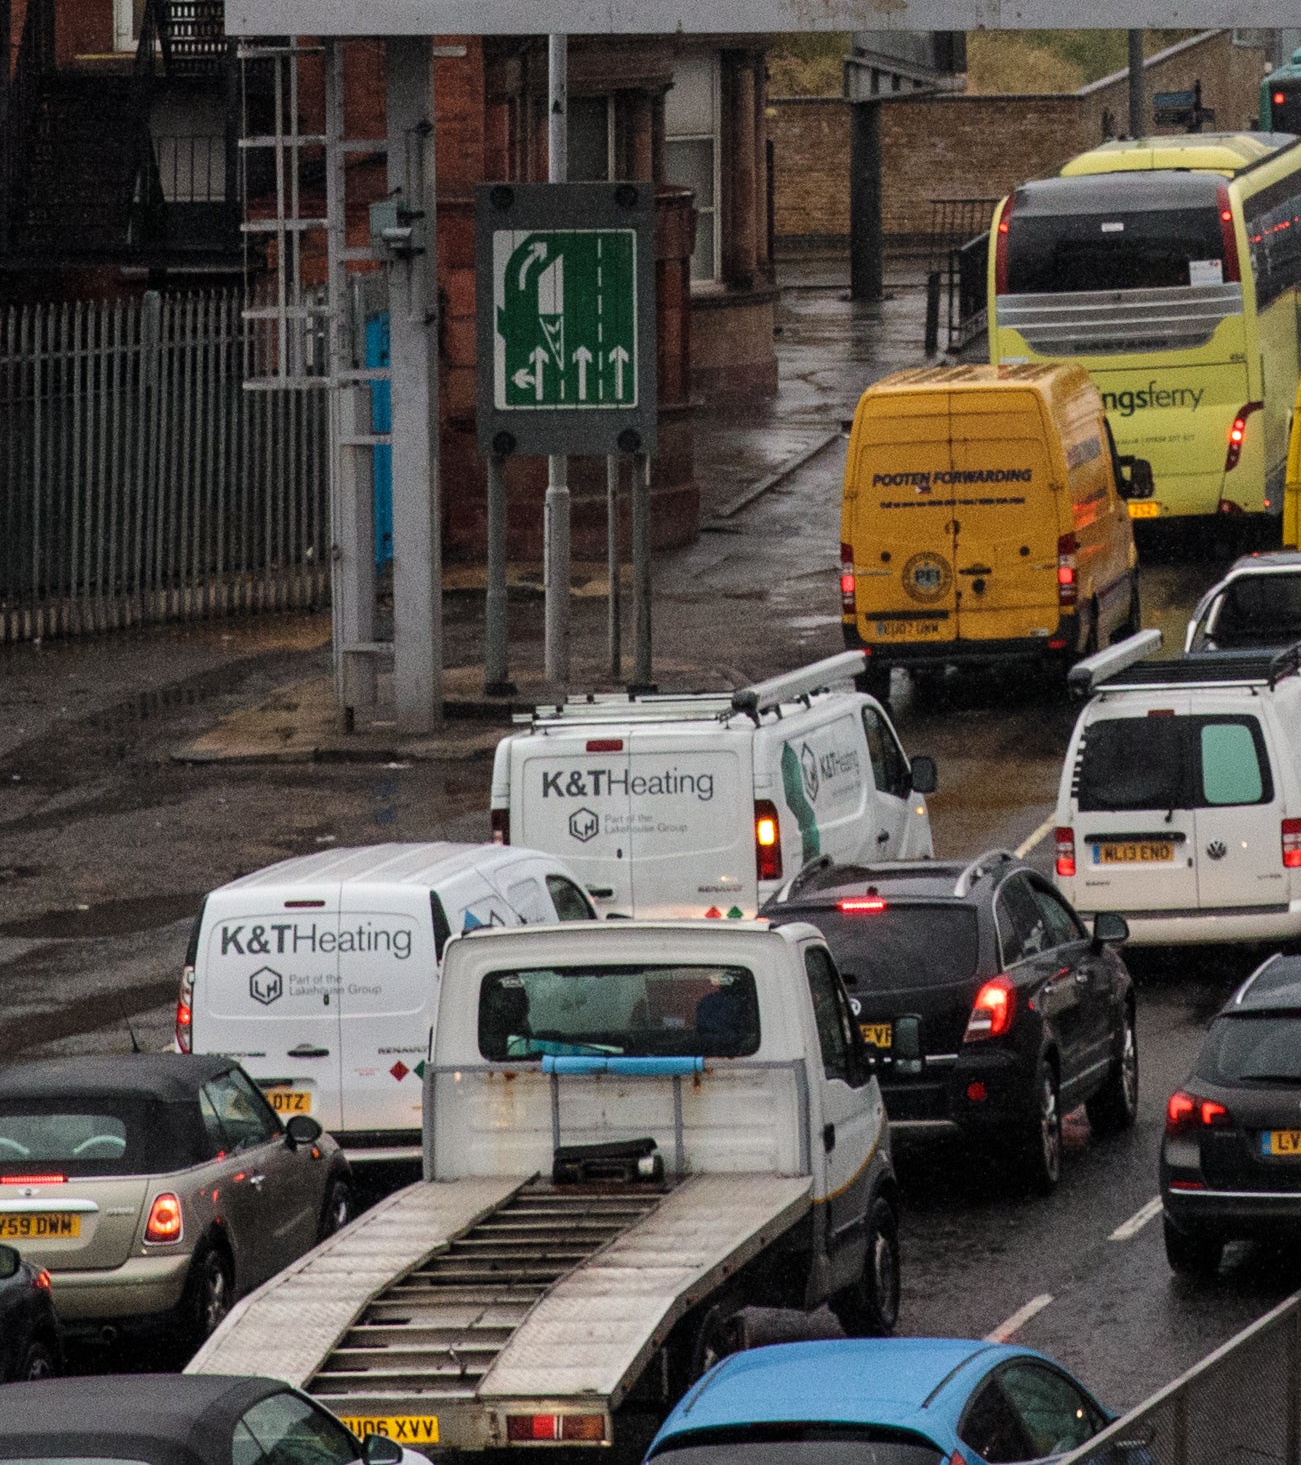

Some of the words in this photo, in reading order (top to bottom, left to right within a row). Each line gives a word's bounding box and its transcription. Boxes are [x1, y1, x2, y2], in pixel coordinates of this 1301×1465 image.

[872, 472, 931, 487] POOTEN
[933, 468, 1033, 484] FORWARDING
[604, 814, 624, 823] Part
[637, 813, 653, 823] the
[657, 822, 689, 835] Group
[289, 974, 309, 985] Part
[313, 973, 325, 985] of
[326, 973, 343, 985] the
[348, 984, 383, 997] Group
[345, 1420, 390, 1438] U06
[395, 1420, 433, 1438] XVV
